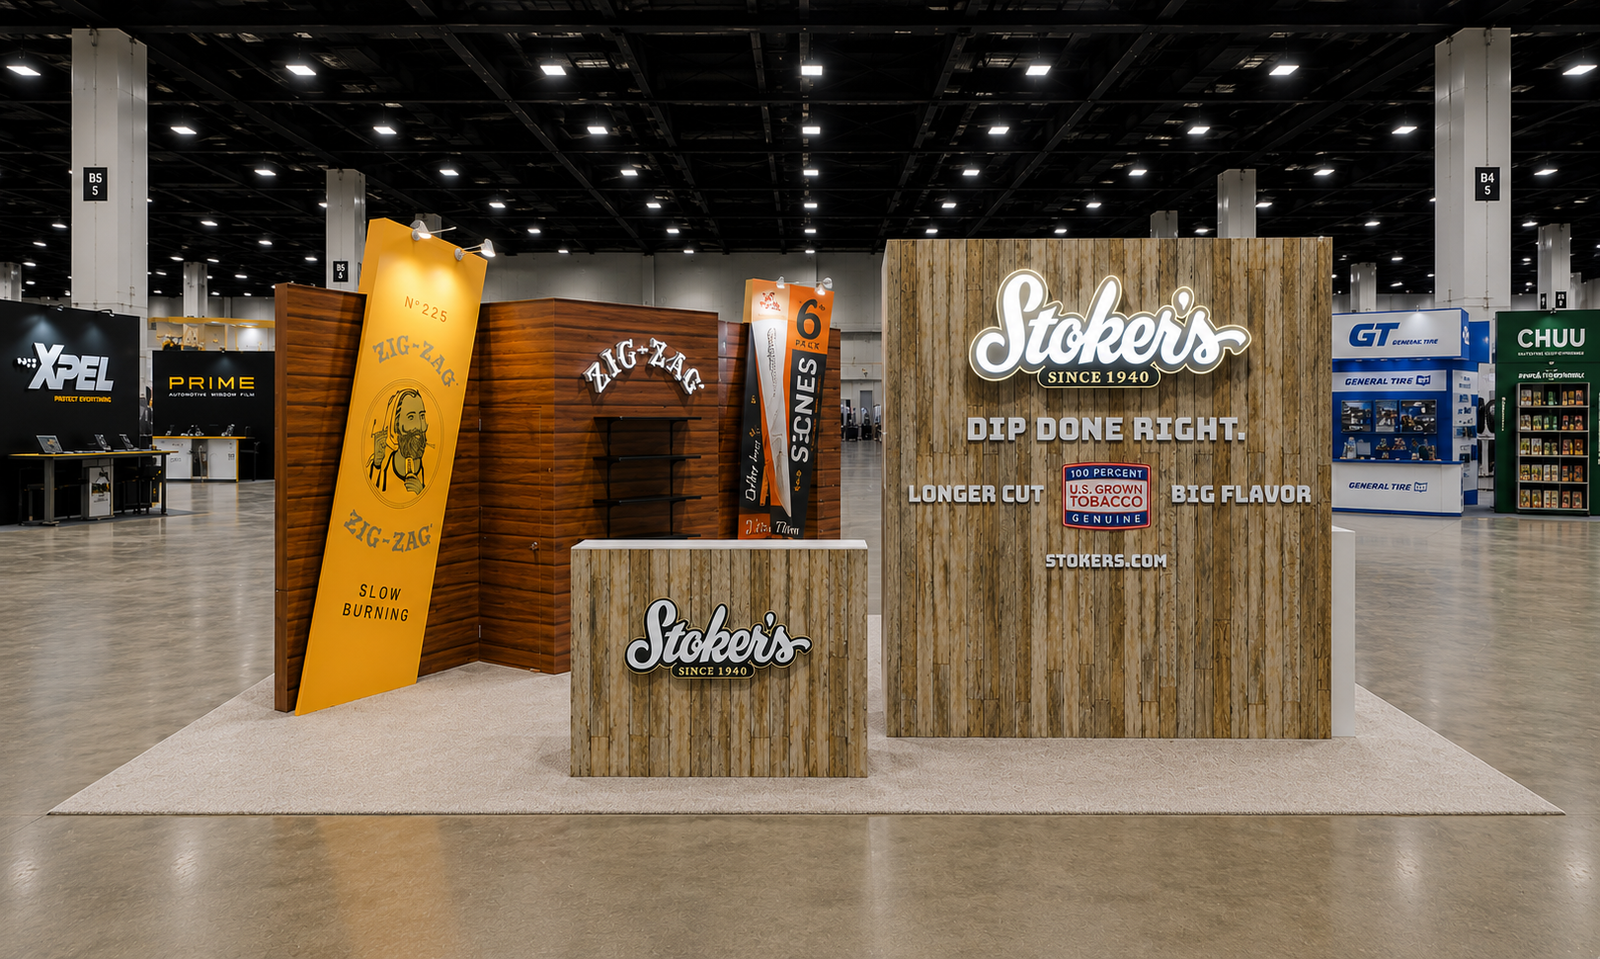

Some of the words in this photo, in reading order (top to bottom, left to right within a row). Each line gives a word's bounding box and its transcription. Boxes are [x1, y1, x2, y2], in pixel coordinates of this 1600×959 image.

[1480, 172, 1495, 183] B4
[796, 298, 822, 340] 6
[976, 274, 1247, 374] Stoker's
[1348, 322, 1401, 347] GT
[1517, 328, 1586, 348] CHUU
[28, 342, 114, 391] XPEL
[168, 376, 255, 390] PRIME
[1048, 371, 1101, 383] SINCE
[1107, 371, 1149, 383] 1940
[1344, 377, 1389, 386] GENERAL
[1391, 377, 1413, 385] TIRE
[967, 417, 1026, 441] DIP
[1037, 417, 1123, 441] DONE
[1133, 417, 1246, 441] RIGHT.
[1071, 469, 1089, 478] 100
[1093, 468, 1142, 479] PERCENT
[908, 484, 996, 503] LONGER
[1002, 484, 1045, 503] CUT
[1070, 484, 1092, 494] U.S.
[1095, 484, 1142, 494] GROWN
[1171, 484, 1215, 504] BIG
[1221, 484, 1312, 504] FLAVOR
[1348, 482, 1389, 490] GENERAL
[1391, 483, 1412, 491] TIRE
[1070, 496, 1143, 507] TOBACCO
[1072, 514, 1140, 524] GENUINE
[1045, 554, 1167, 569] STOKERS.COM
[359, 583, 401, 601] SLOW
[342, 603, 409, 621] BURNING
[626, 600, 811, 669] Stoker's
[678, 666, 714, 676] SINCE
[718, 666, 748, 676] 1940
